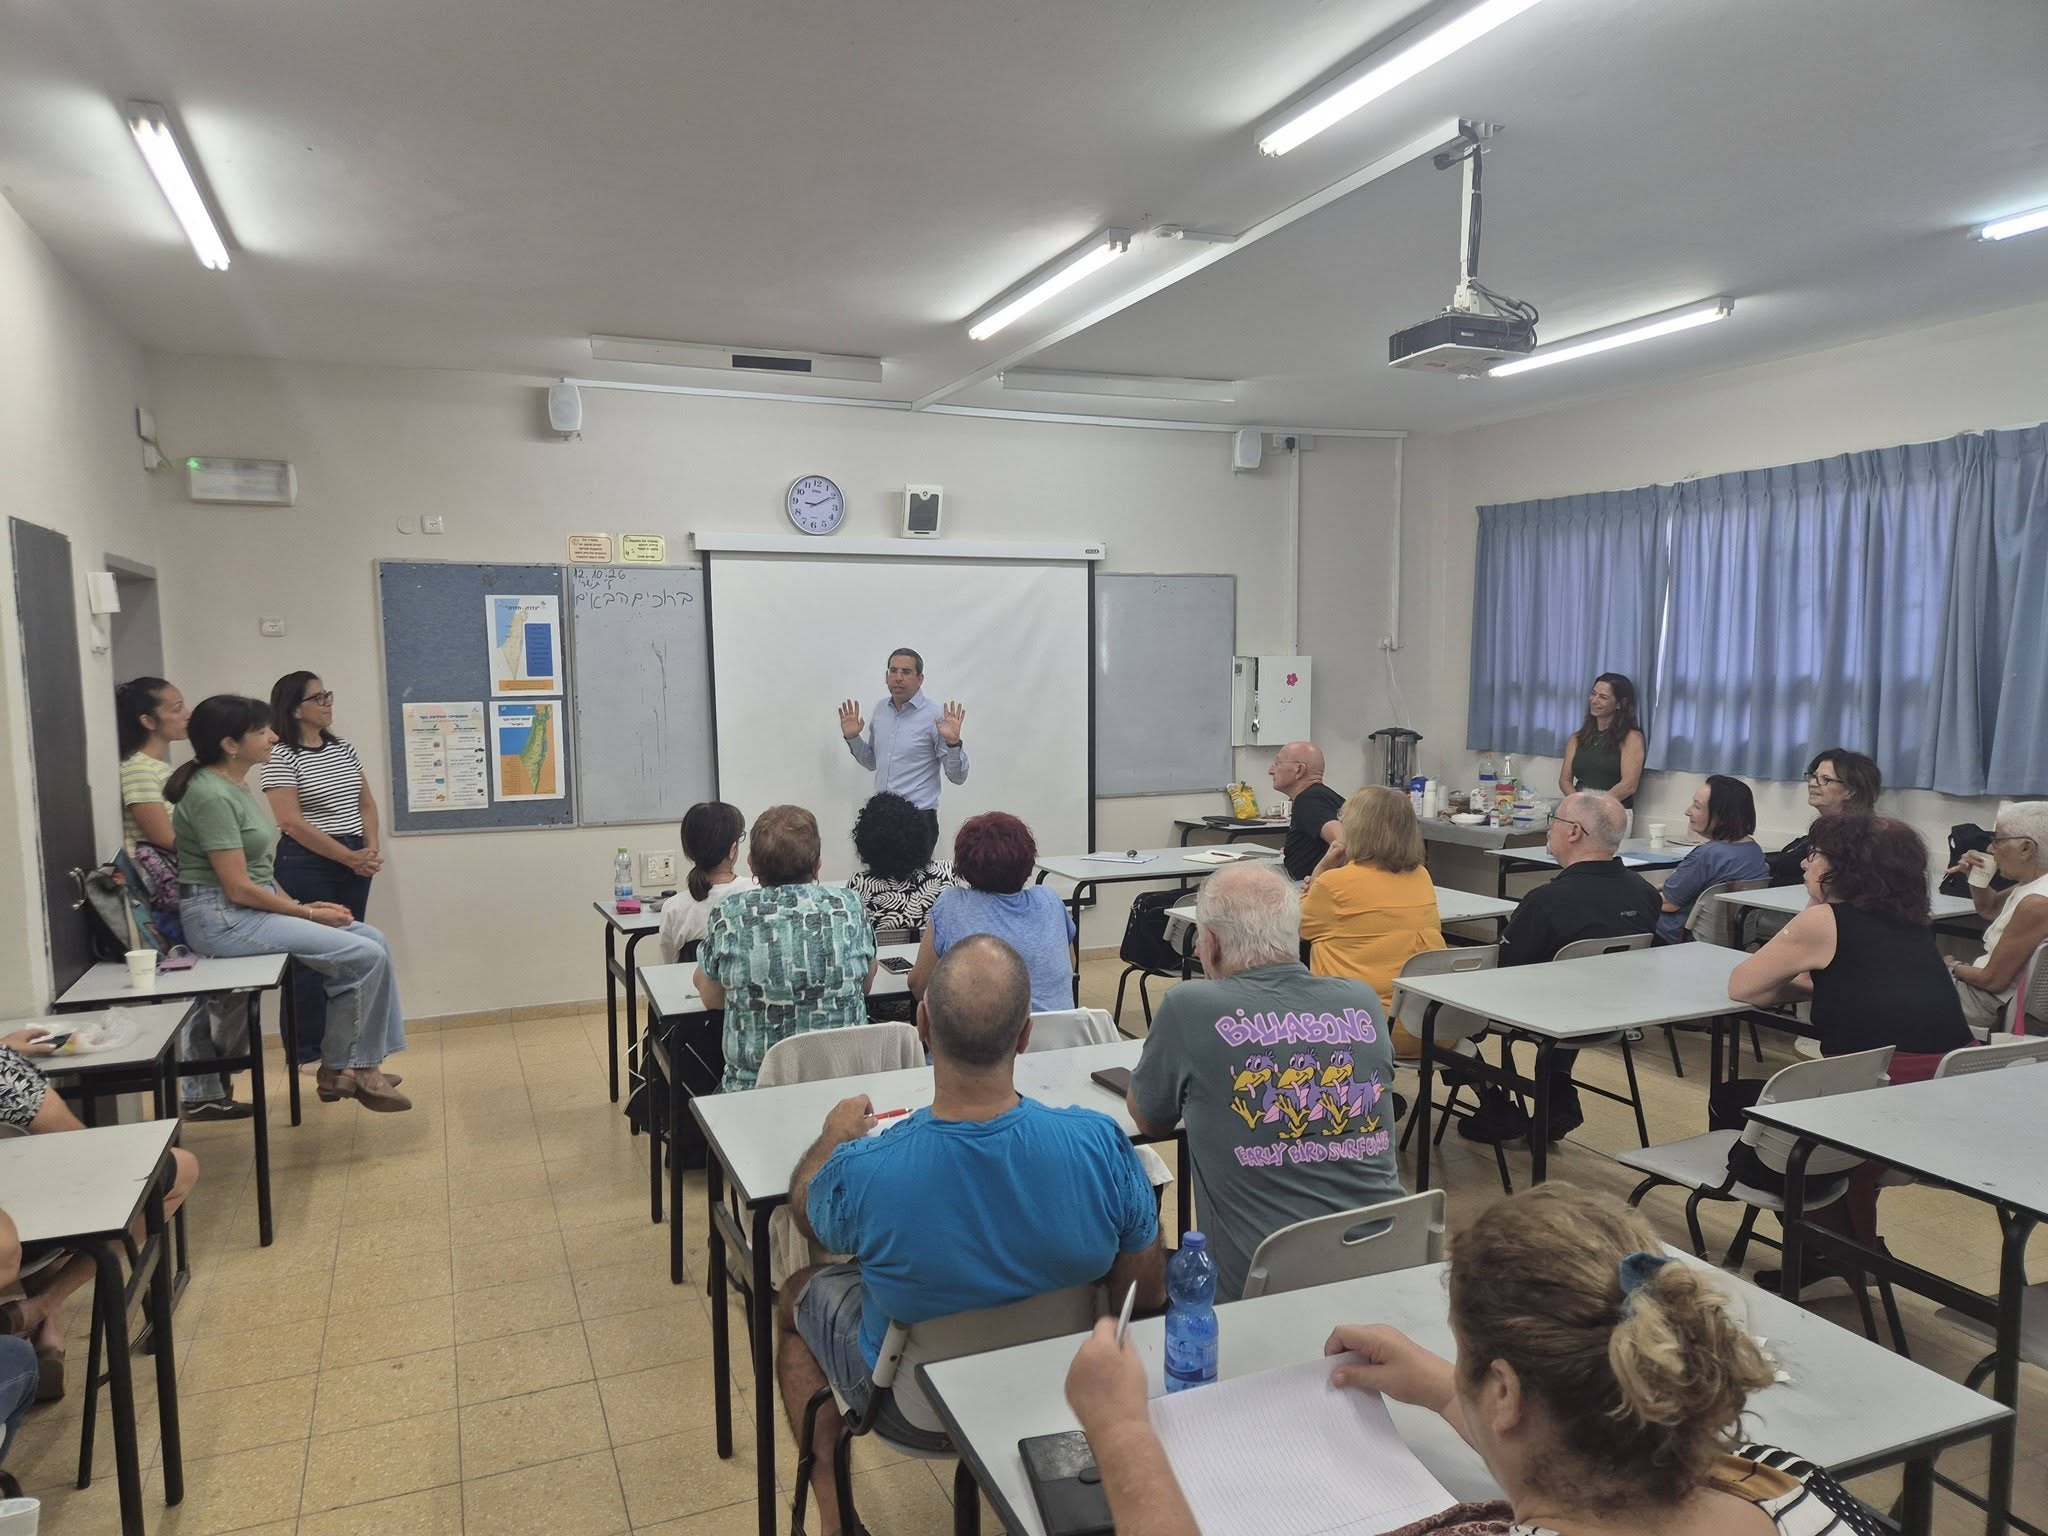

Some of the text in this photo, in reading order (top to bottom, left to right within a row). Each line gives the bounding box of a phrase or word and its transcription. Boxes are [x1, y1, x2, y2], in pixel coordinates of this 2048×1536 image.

[805, 481, 811, 489] 11
[813, 480, 823, 488] 12
[797, 488, 805, 496] 10
[830, 492, 836, 500] 2
[792, 497, 799, 505] 9
[794, 508, 801, 516] 8
[801, 517, 808, 525] 7
[828, 513, 834, 521] 4
[810, 521, 817, 529] 6
[821, 520, 827, 528] 5
[576, 589, 694, 610] ברוכים הבאים
[1215, 1008, 1377, 1047] BILLABONG
[1234, 1142, 1288, 1166] EARLY
[1288, 1139, 1328, 1163] BIRD
[1328, 1136, 1366, 1161] SURF
